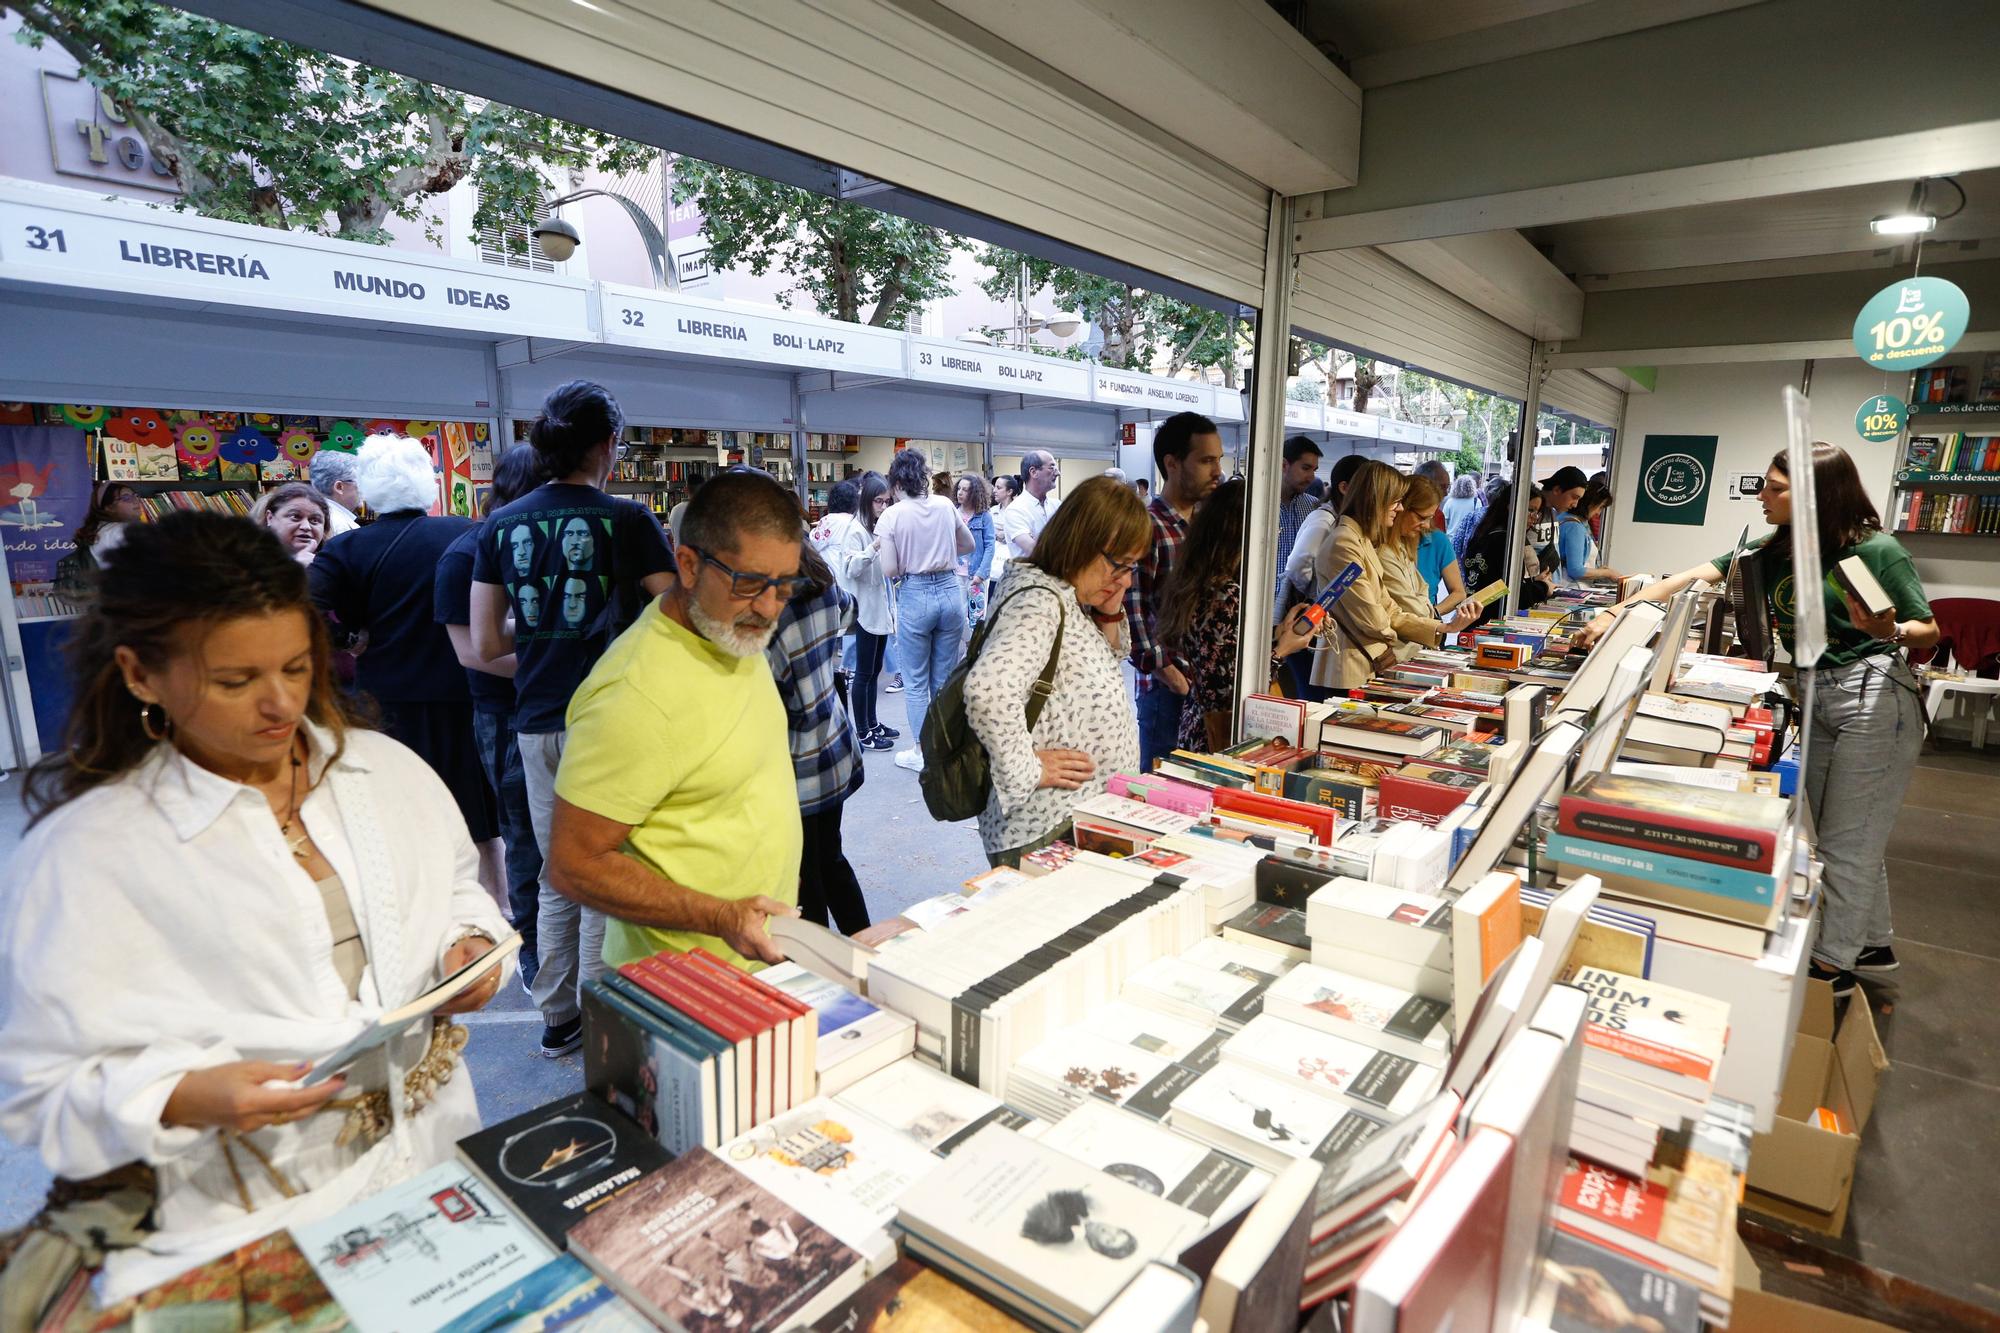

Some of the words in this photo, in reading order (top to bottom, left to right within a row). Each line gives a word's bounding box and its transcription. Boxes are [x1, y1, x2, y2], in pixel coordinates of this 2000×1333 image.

[25, 225, 67, 253] 31
[119, 240, 270, 280] LIBRERÍA
[334, 270, 425, 300] MUNDO
[447, 287, 510, 311] IDEAS
[621, 309, 644, 327] 32
[1870, 310, 1945, 350] 10%
[1870, 353, 1884, 361] de
[1887, 345, 1945, 359] descuento
[920, 352, 932, 365] 33
[999, 365, 1017, 378] BOLI
[1099, 379, 1107, 389] 34
[1148, 386, 1174, 400] ANSELMO
[1175, 392, 1199, 404] LORENZO
[1940, 405, 1960, 413] 10%
[1961, 404, 1974, 412] de
[1863, 413, 1898, 431] 10%
[1674, 456, 1692, 465] desde
[1929, 473, 1949, 481] 10%
[1950, 473, 1963, 481] de
[1668, 494, 1687, 502] AÑOS
[44, 539, 78, 551] idea
[1319, 788, 1332, 802] DE
[1333, 797, 1345, 812] EL
[1582, 970, 1619, 987] IN
[1590, 997, 1631, 1016] LE
